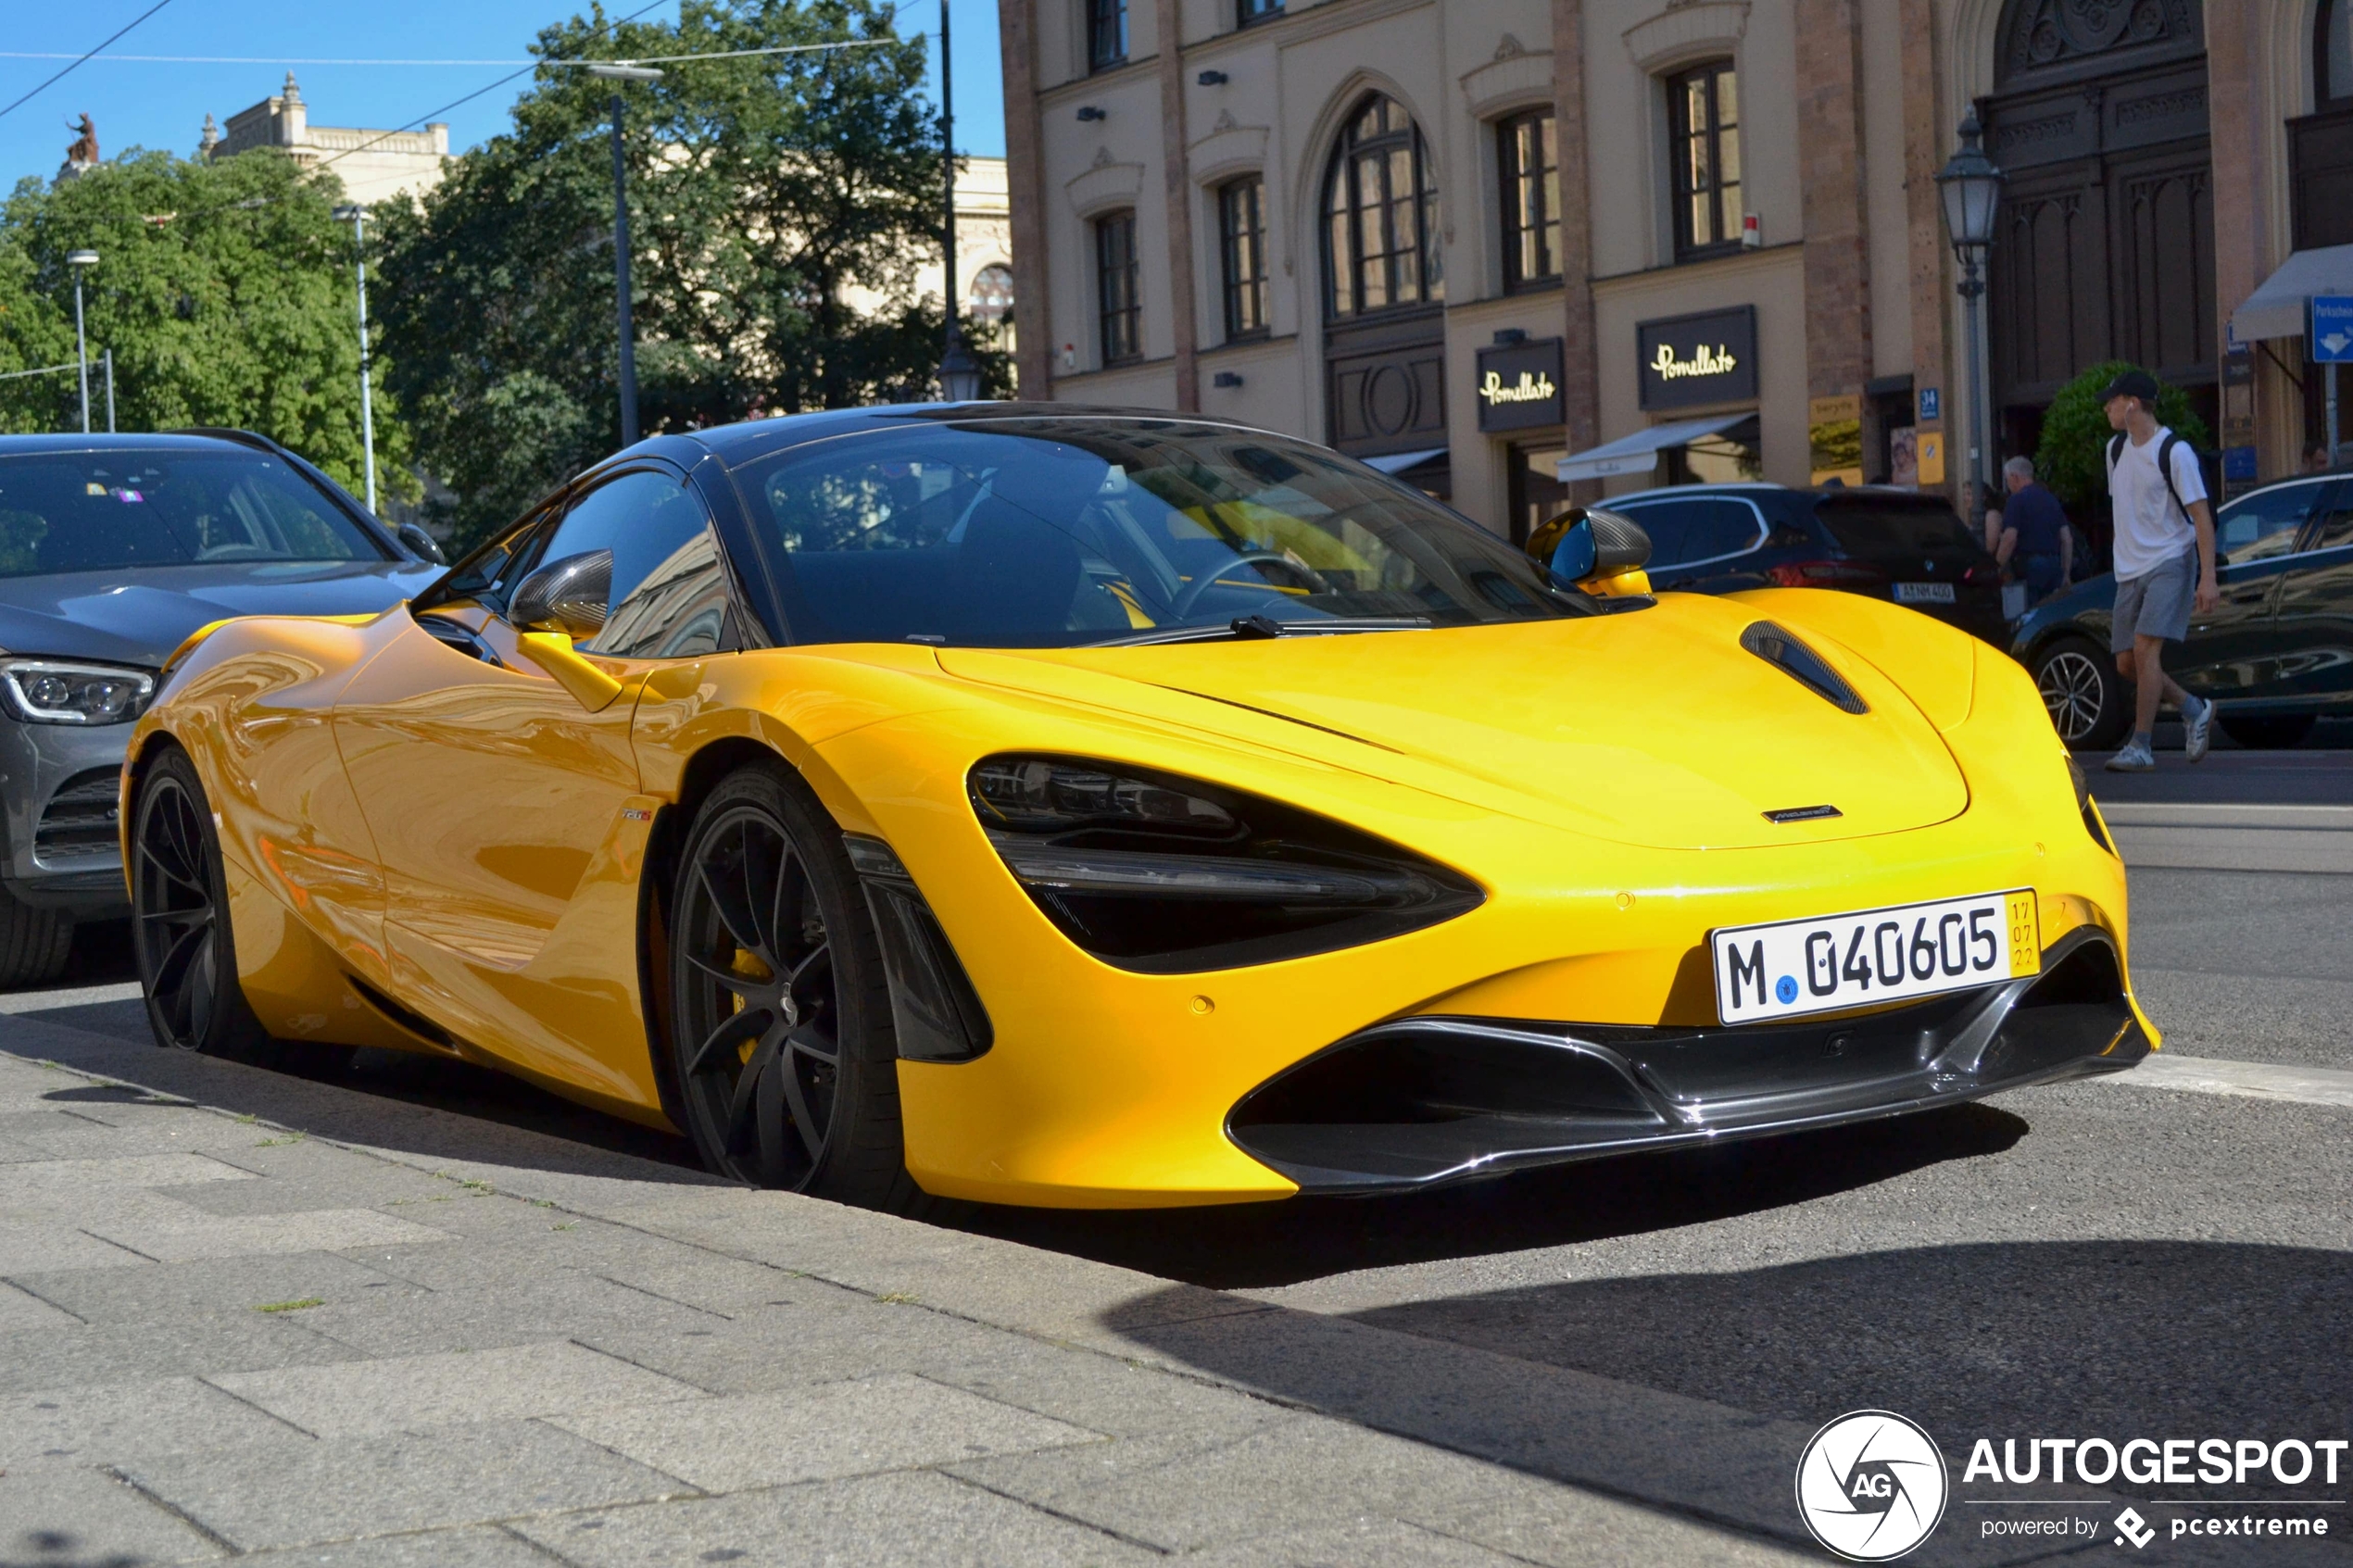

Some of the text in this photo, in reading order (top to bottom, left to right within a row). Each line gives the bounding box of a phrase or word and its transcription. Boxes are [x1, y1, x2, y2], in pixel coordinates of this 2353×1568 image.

[1650, 344, 1737, 381] Pomellato
[1479, 370, 1555, 405] Pomellato
[2012, 902, 2029, 920] 17
[2013, 925, 2031, 943] 07
[1806, 908, 1997, 997] 040605
[2015, 947, 2032, 967] 22
